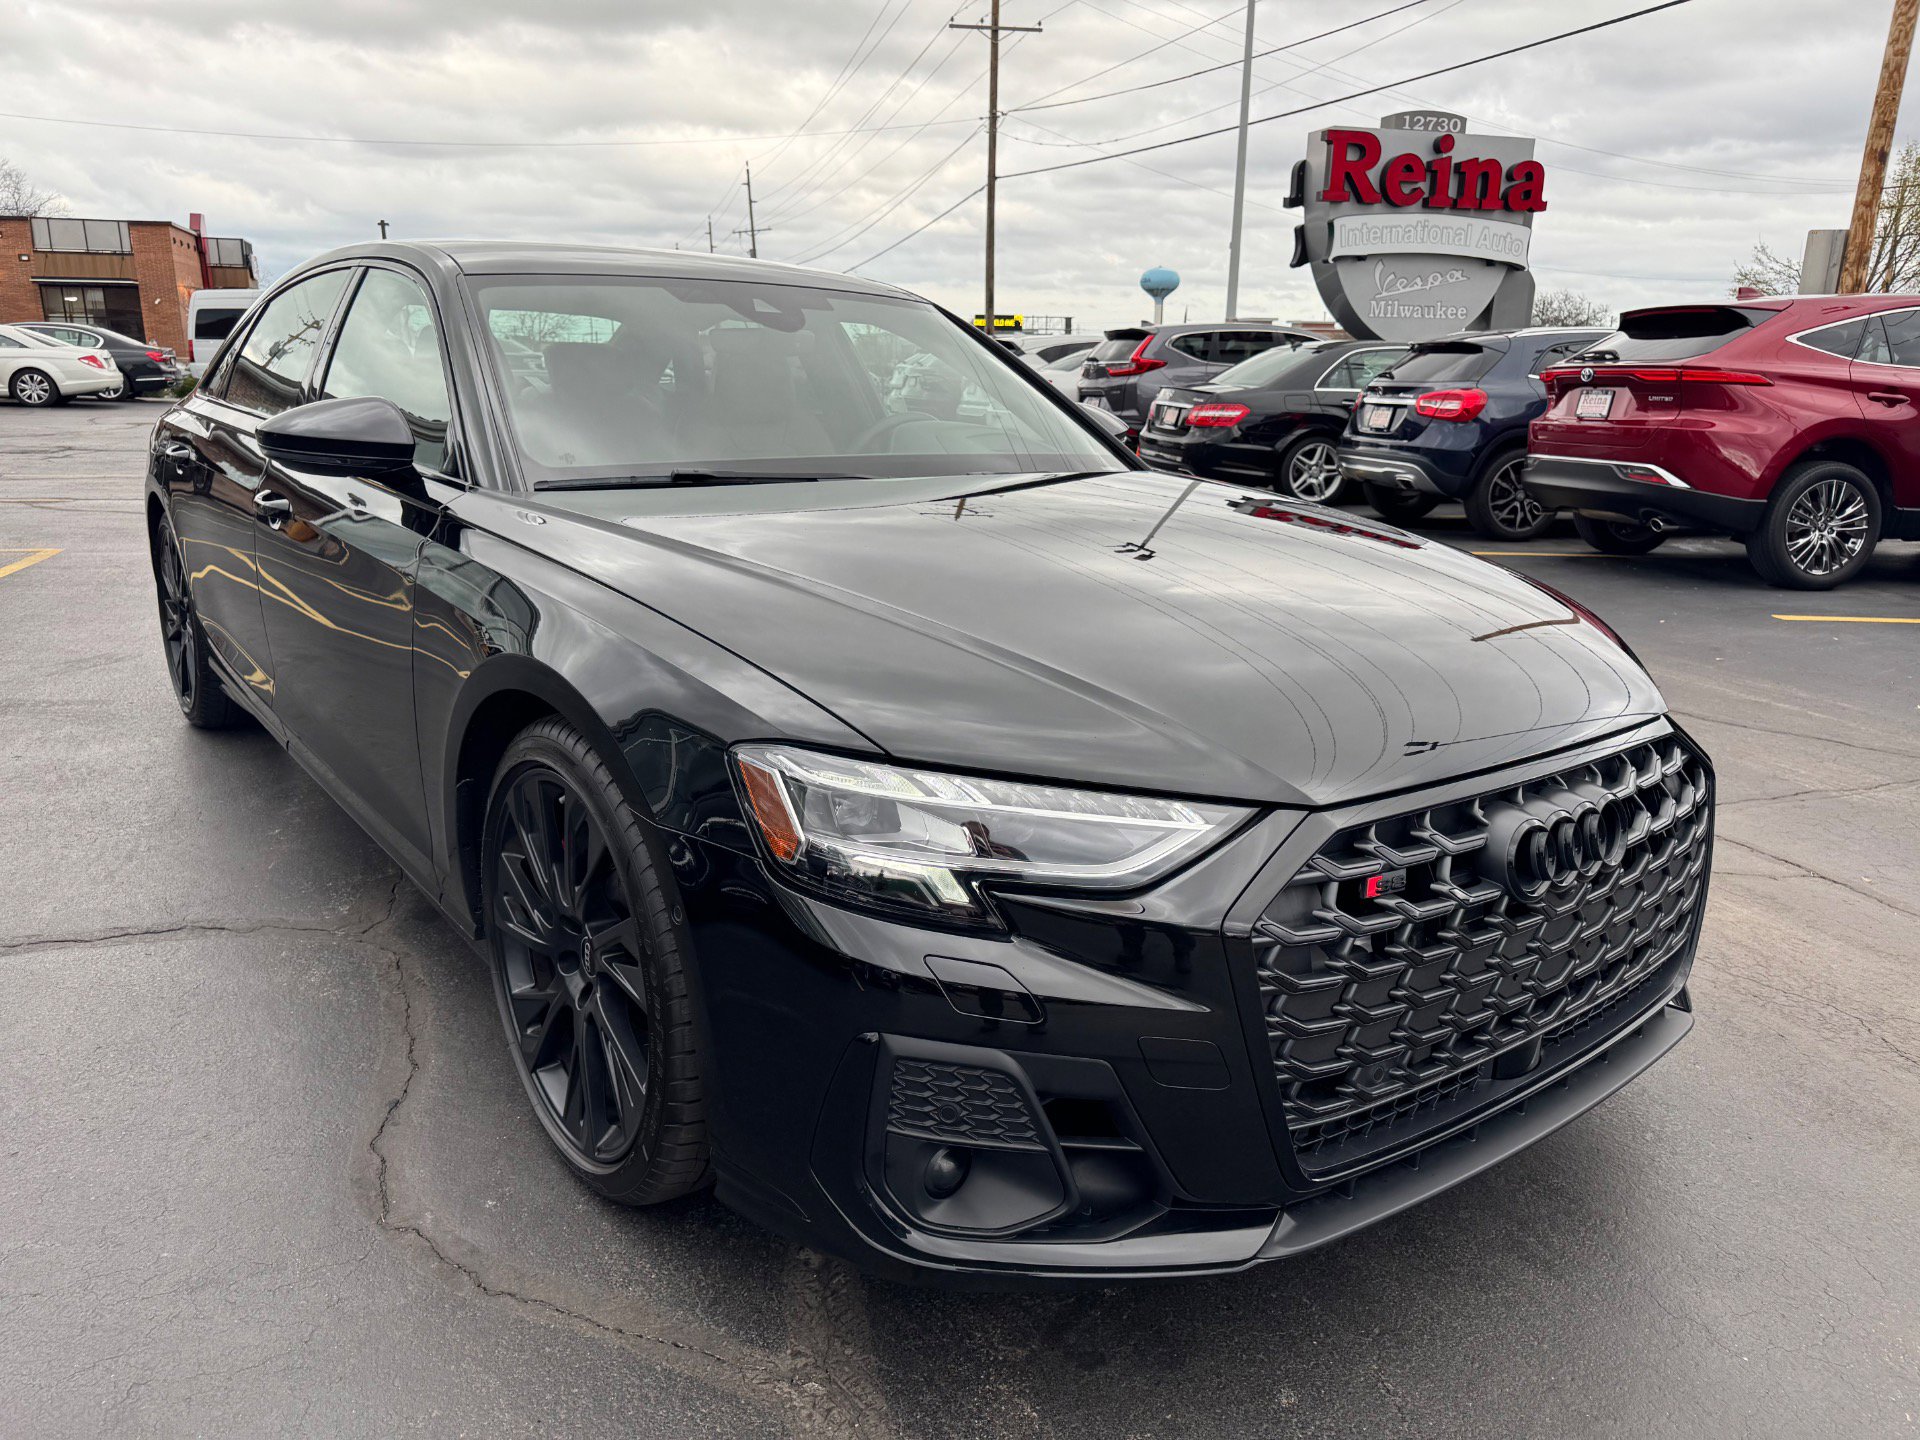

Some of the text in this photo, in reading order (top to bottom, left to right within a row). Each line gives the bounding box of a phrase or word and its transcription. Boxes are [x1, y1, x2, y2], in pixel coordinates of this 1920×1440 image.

[1402, 115, 1462, 133] 12730
[1319, 129, 1548, 212] Reina
[1340, 219, 1525, 257] International Auto
[1374, 259, 1471, 298] Vespa
[1368, 299, 1468, 320] Milwaukee
[1582, 395, 1608, 405] Reina
